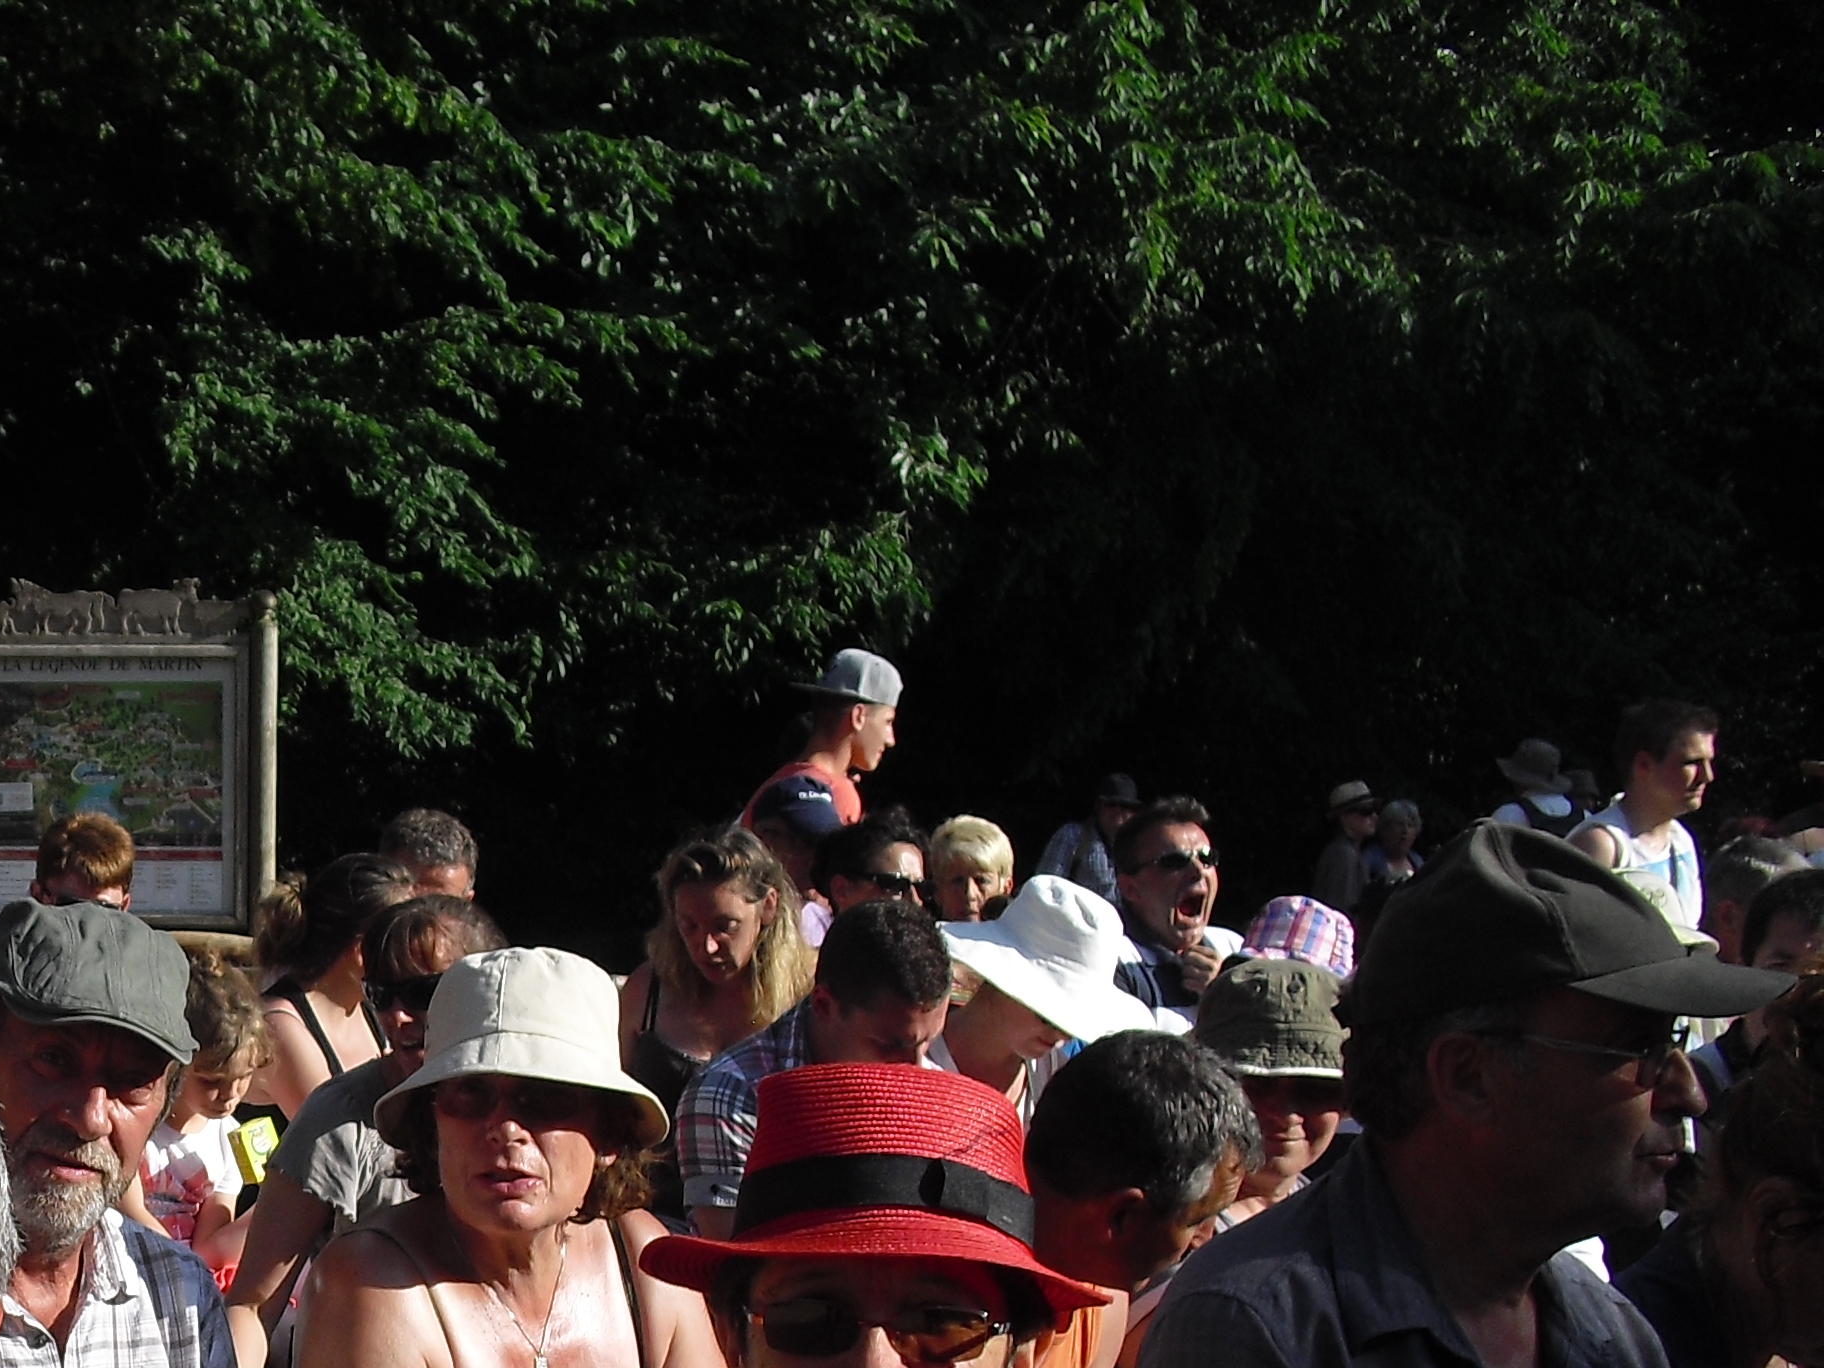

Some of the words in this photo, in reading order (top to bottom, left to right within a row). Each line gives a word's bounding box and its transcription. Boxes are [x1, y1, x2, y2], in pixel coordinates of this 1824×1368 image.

[2, 658, 22, 672] LA
[109, 658, 132, 672] DE
[139, 657, 203, 672] MARTIN
